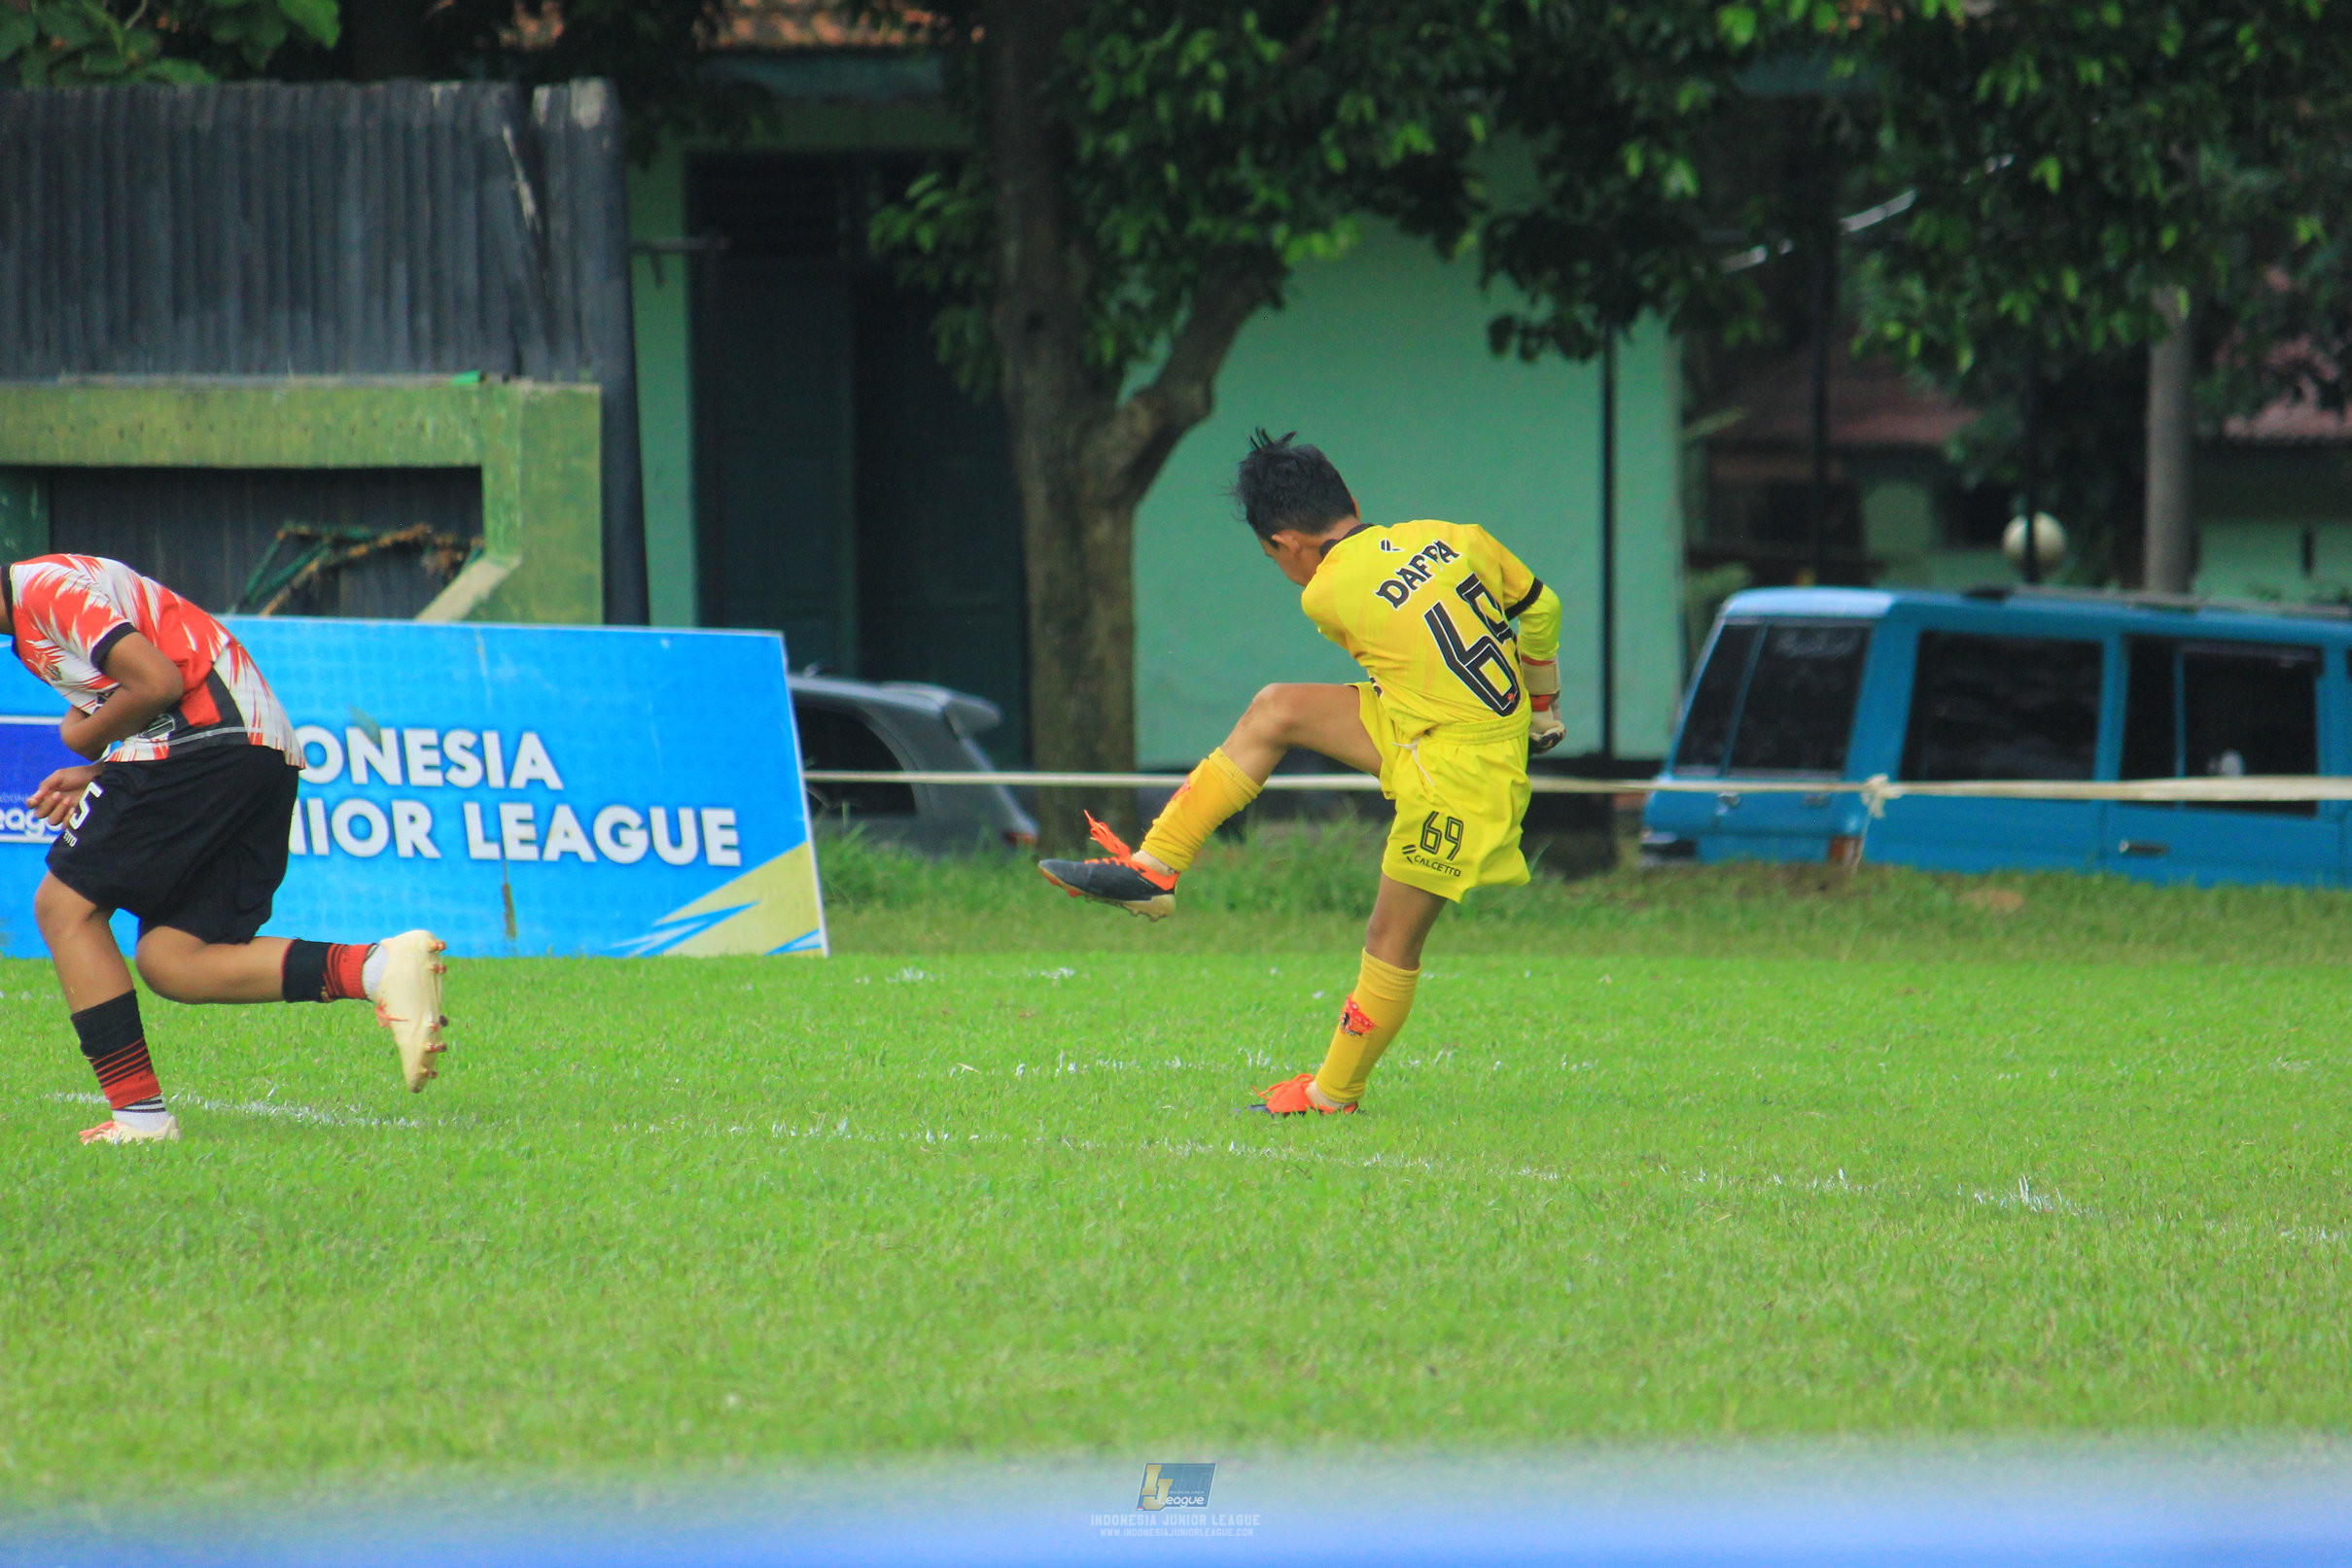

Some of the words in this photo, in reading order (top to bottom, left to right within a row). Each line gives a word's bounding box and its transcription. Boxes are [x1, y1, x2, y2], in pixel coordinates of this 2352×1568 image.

[1422, 571, 1524, 718] 69
[462, 801, 742, 867] LEAGUE
[1420, 810, 1464, 861] 69
[1414, 854, 1461, 878] CALCETTO
